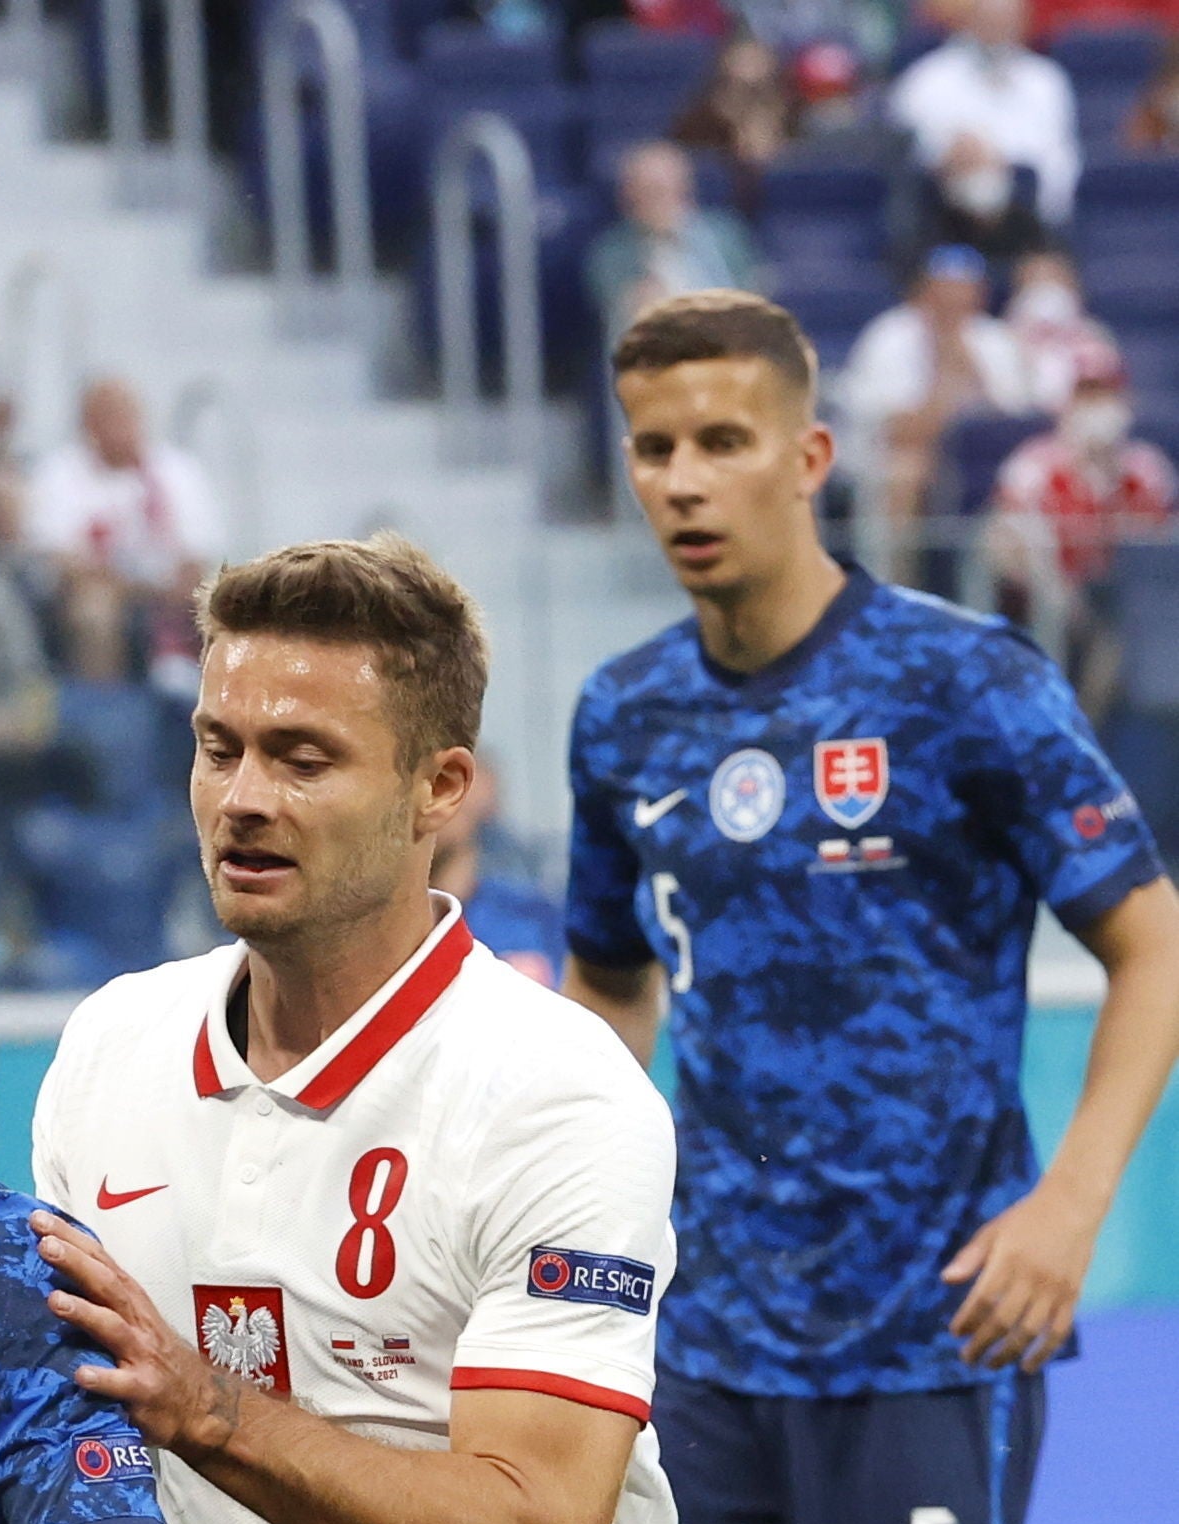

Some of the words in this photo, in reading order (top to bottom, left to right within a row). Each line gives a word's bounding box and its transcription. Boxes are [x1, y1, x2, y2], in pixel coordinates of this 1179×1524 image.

[651, 872, 694, 994] 5
[335, 1147, 409, 1299] 8
[573, 1266, 652, 1301] RESPECT
